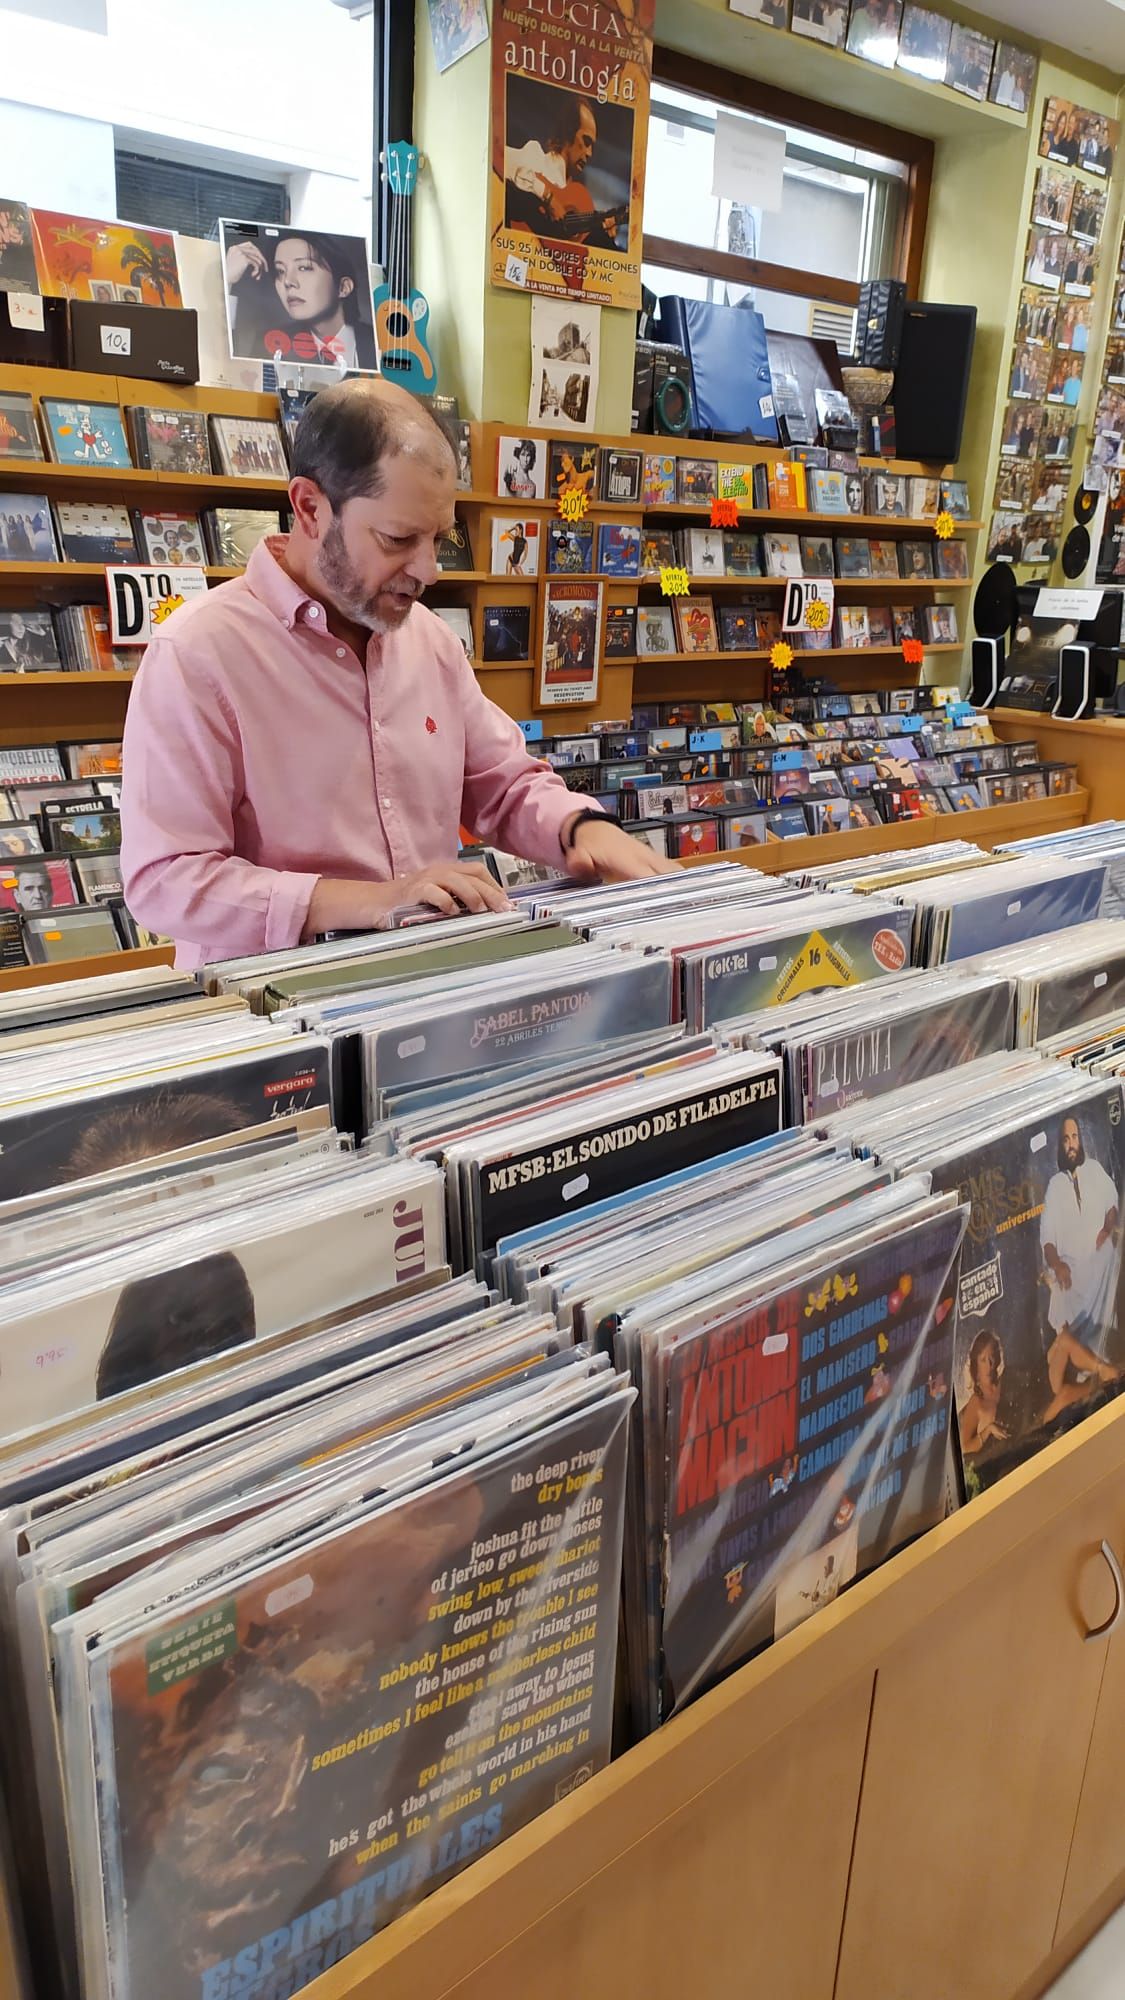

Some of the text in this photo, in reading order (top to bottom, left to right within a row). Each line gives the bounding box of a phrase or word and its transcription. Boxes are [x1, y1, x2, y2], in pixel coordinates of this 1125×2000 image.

[503, 8, 645, 64] NUEVO DISCO YA A LA VENTA
[525, 0, 624, 40] LUCÍA
[504, 39, 636, 105] antología
[496, 237, 638, 274] SUS 25 MEJORES CANCIONES
[540, 259, 573, 276] DOBLE
[576, 267, 587, 279] CD
[591, 269, 597, 279] Y
[600, 271, 613, 283] MC
[539, 283, 556, 293] VENTA
[556, 286, 567, 294] POR
[563, 496, 585, 515] 20%
[776, 959, 805, 1001] ORIGINALES
[809, 947, 821, 967] 16
[470, 992, 592, 1048] ISABEL PANTOJA
[495, 1028, 543, 1048] 22 ABRILES
[267, 1077, 313, 1093] vergara
[817, 1024, 891, 1096] PALOMA
[488, 1077, 777, 1194] MFSB: EL SONIDO DE FILADELFIA
[961, 1264, 997, 1290] cantado
[962, 1282, 999, 1312] español
[975, 1282, 986, 1295] en
[802, 1327, 826, 1362] DOS
[829, 1295, 888, 1347] GARDENIAS
[680, 1327, 798, 1446] ANTONIO
[800, 1340, 876, 1403] EL MANISERO
[799, 1385, 864, 1442] MADRECITA
[511, 1447, 607, 1493] the deep river
[676, 1384, 798, 1517] MACHIN
[537, 1482, 563, 1504] dry
[430, 1572, 447, 1594] of
[448, 1558, 494, 1592] jerico
[498, 1549, 516, 1571] go
[520, 1532, 559, 1559] down
[469, 1528, 519, 1565] joshua
[520, 1520, 538, 1541] fit
[540, 1513, 562, 1533] the
[428, 1586, 473, 1622] swing
[507, 1560, 549, 1590] sweet
[453, 1560, 600, 1635] down by the riverside
[149, 1622, 235, 1673] ETIQUETA
[161, 1612, 223, 1650] SERIE
[379, 1651, 438, 1692] nobody
[440, 1630, 489, 1664] knows
[491, 1617, 514, 1639] the
[515, 1595, 565, 1630] trouble
[576, 1583, 599, 1605] see
[415, 1604, 597, 1699] the house of the rising sun
[162, 1644, 225, 1682] VERDE
[506, 1674, 541, 1702] away
[544, 1666, 558, 1684] to
[560, 1650, 595, 1678] jesus
[311, 1715, 401, 1772] sometimes
[414, 1691, 443, 1724] feel
[446, 1683, 473, 1707] like
[474, 1677, 483, 1690] a
[563, 1622, 597, 1650] child
[501, 1696, 530, 1721] saw
[531, 1684, 553, 1705] the
[556, 1662, 594, 1693] wheel
[418, 1765, 437, 1789] go
[439, 1746, 464, 1774] tell
[477, 1734, 496, 1751] on
[498, 1720, 521, 1742] the
[521, 1684, 593, 1731] mountains
[355, 1830, 398, 1864] when
[406, 1814, 431, 1838] the
[489, 1772, 507, 1796] go
[510, 1735, 575, 1781] marching
[577, 1728, 590, 1744] in
[367, 1807, 393, 1839] got
[401, 1795, 427, 1817] the
[428, 1770, 472, 1801] whole
[476, 1741, 518, 1777] world
[519, 1735, 533, 1754] in
[536, 1723, 558, 1745] his
[559, 1703, 592, 1734] hand
